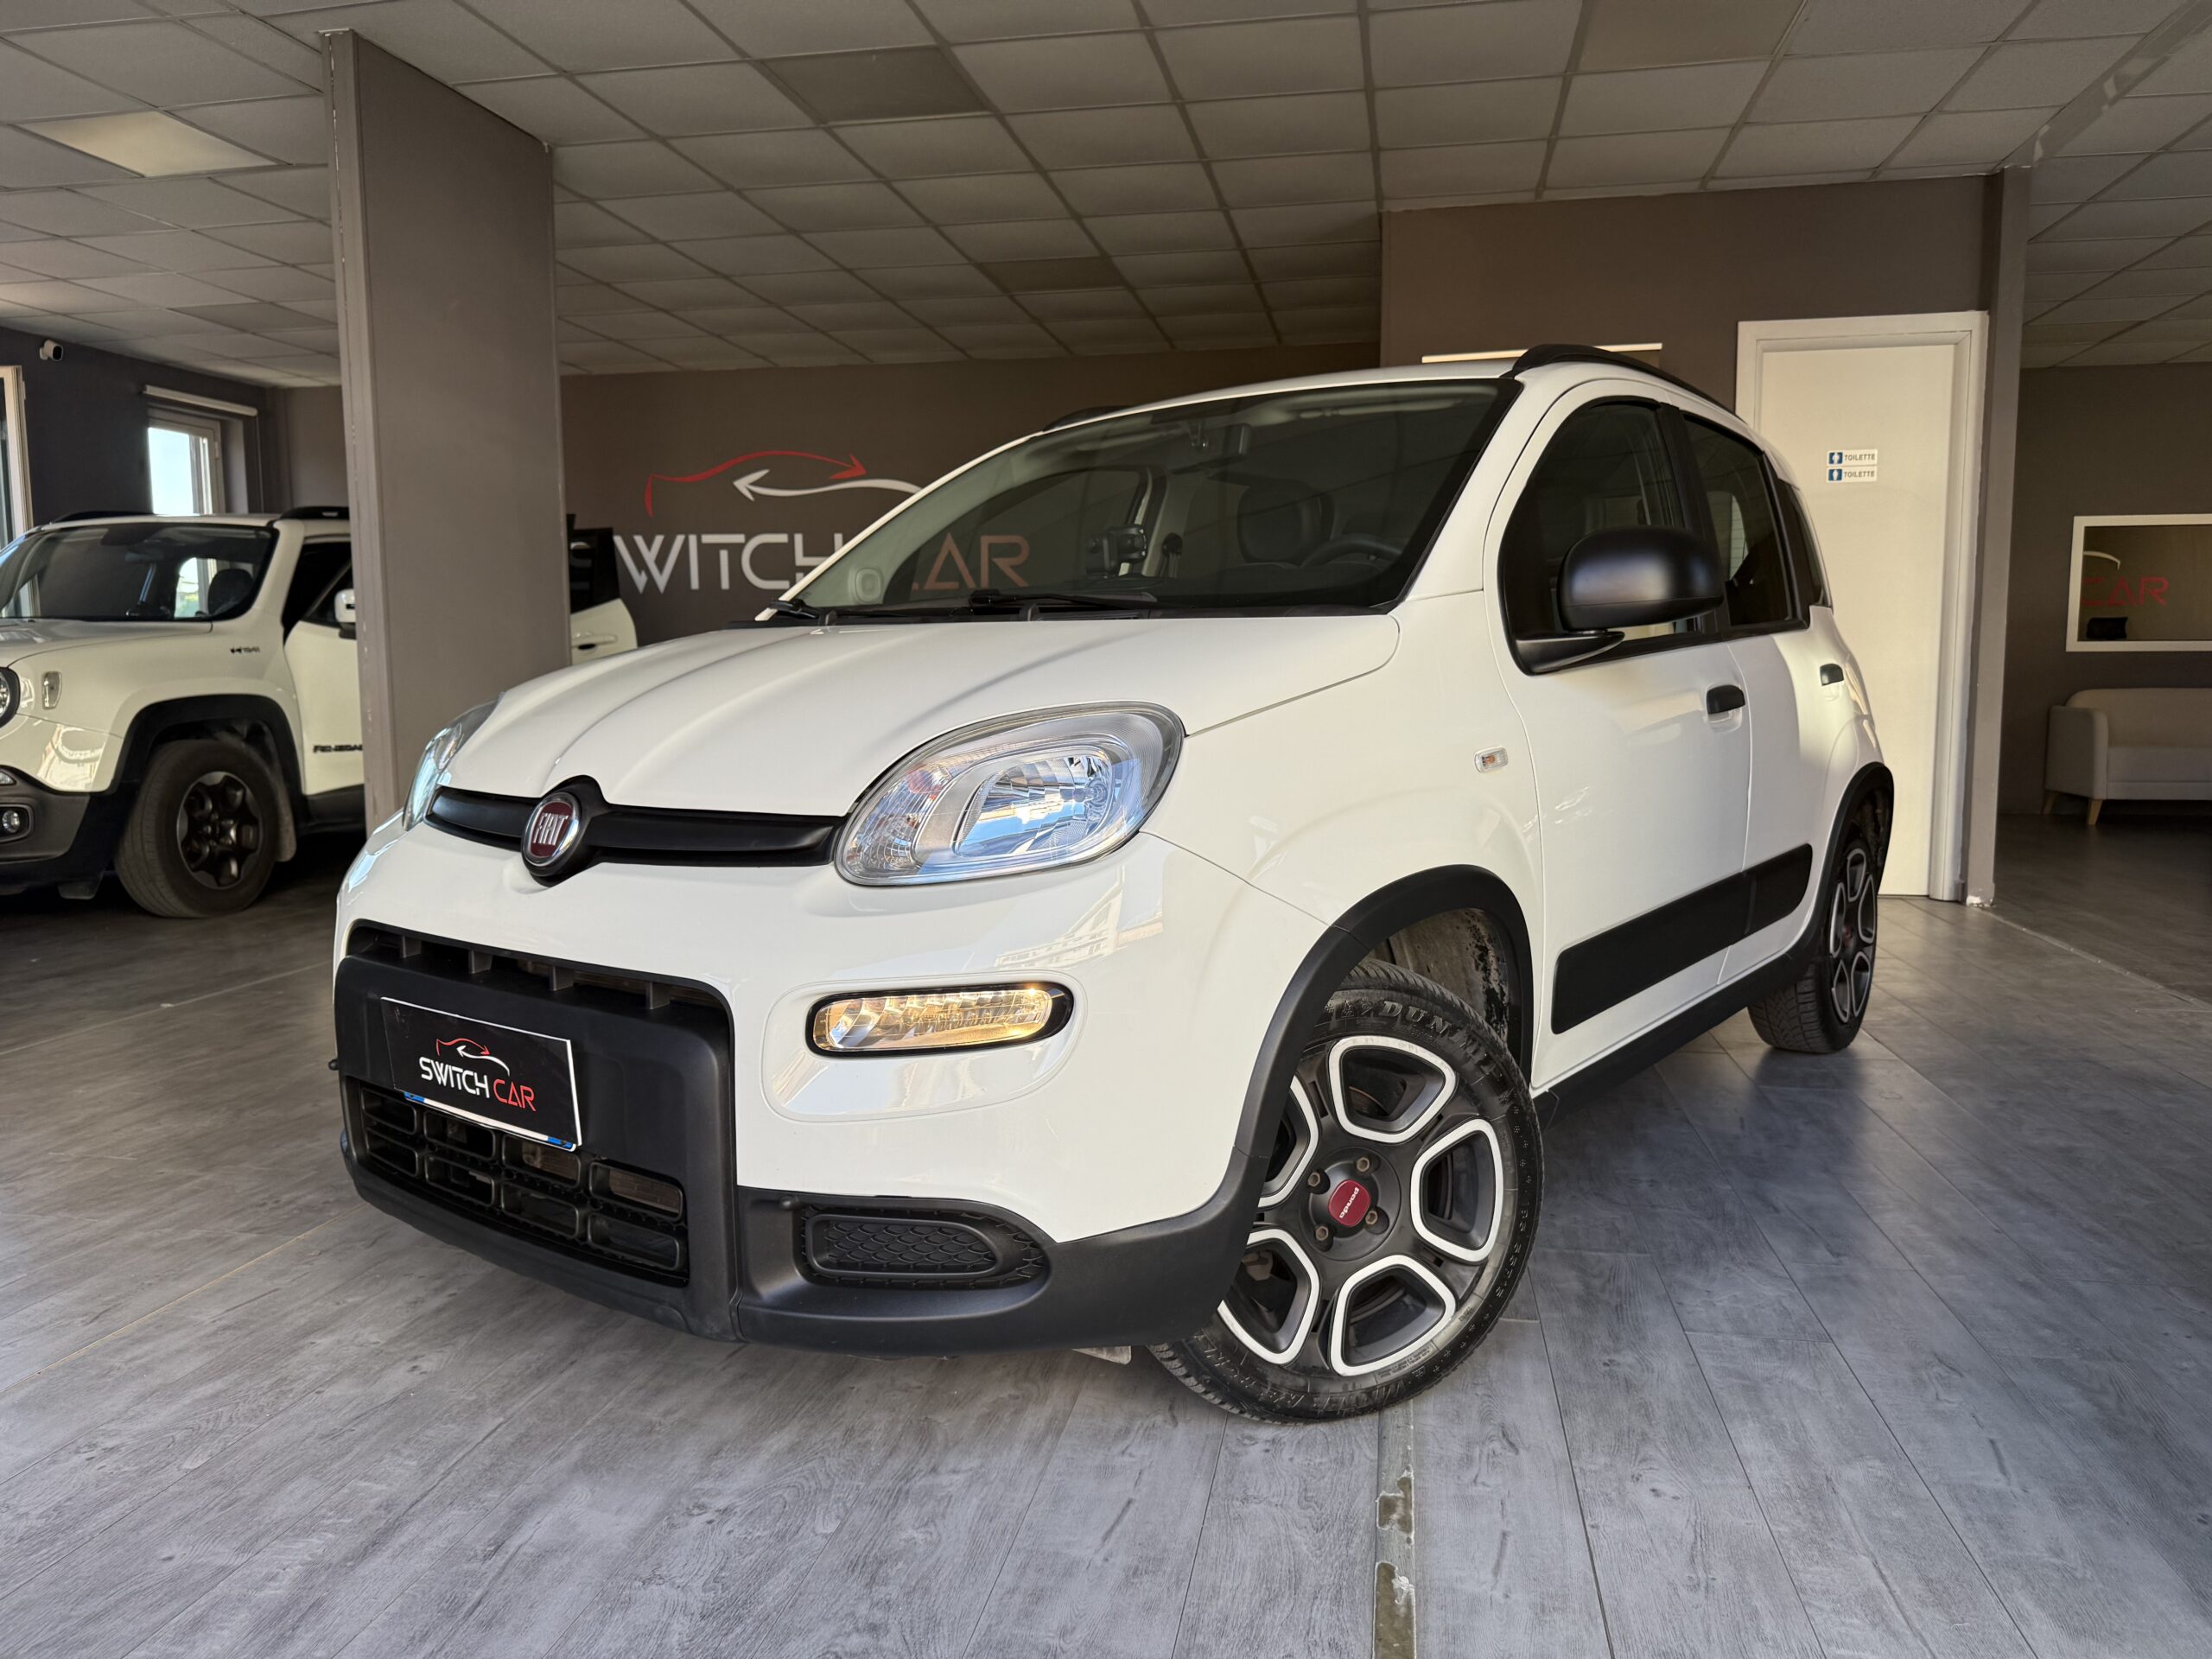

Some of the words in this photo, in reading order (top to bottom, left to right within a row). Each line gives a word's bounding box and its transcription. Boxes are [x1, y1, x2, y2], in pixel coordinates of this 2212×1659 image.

[912, 532, 1031, 590] AR
[532, 812, 569, 846] FIAT
[419, 1056, 491, 1098] SWITCH
[493, 1078, 537, 1112] CAR
[1338, 1186, 1360, 1219] panda
